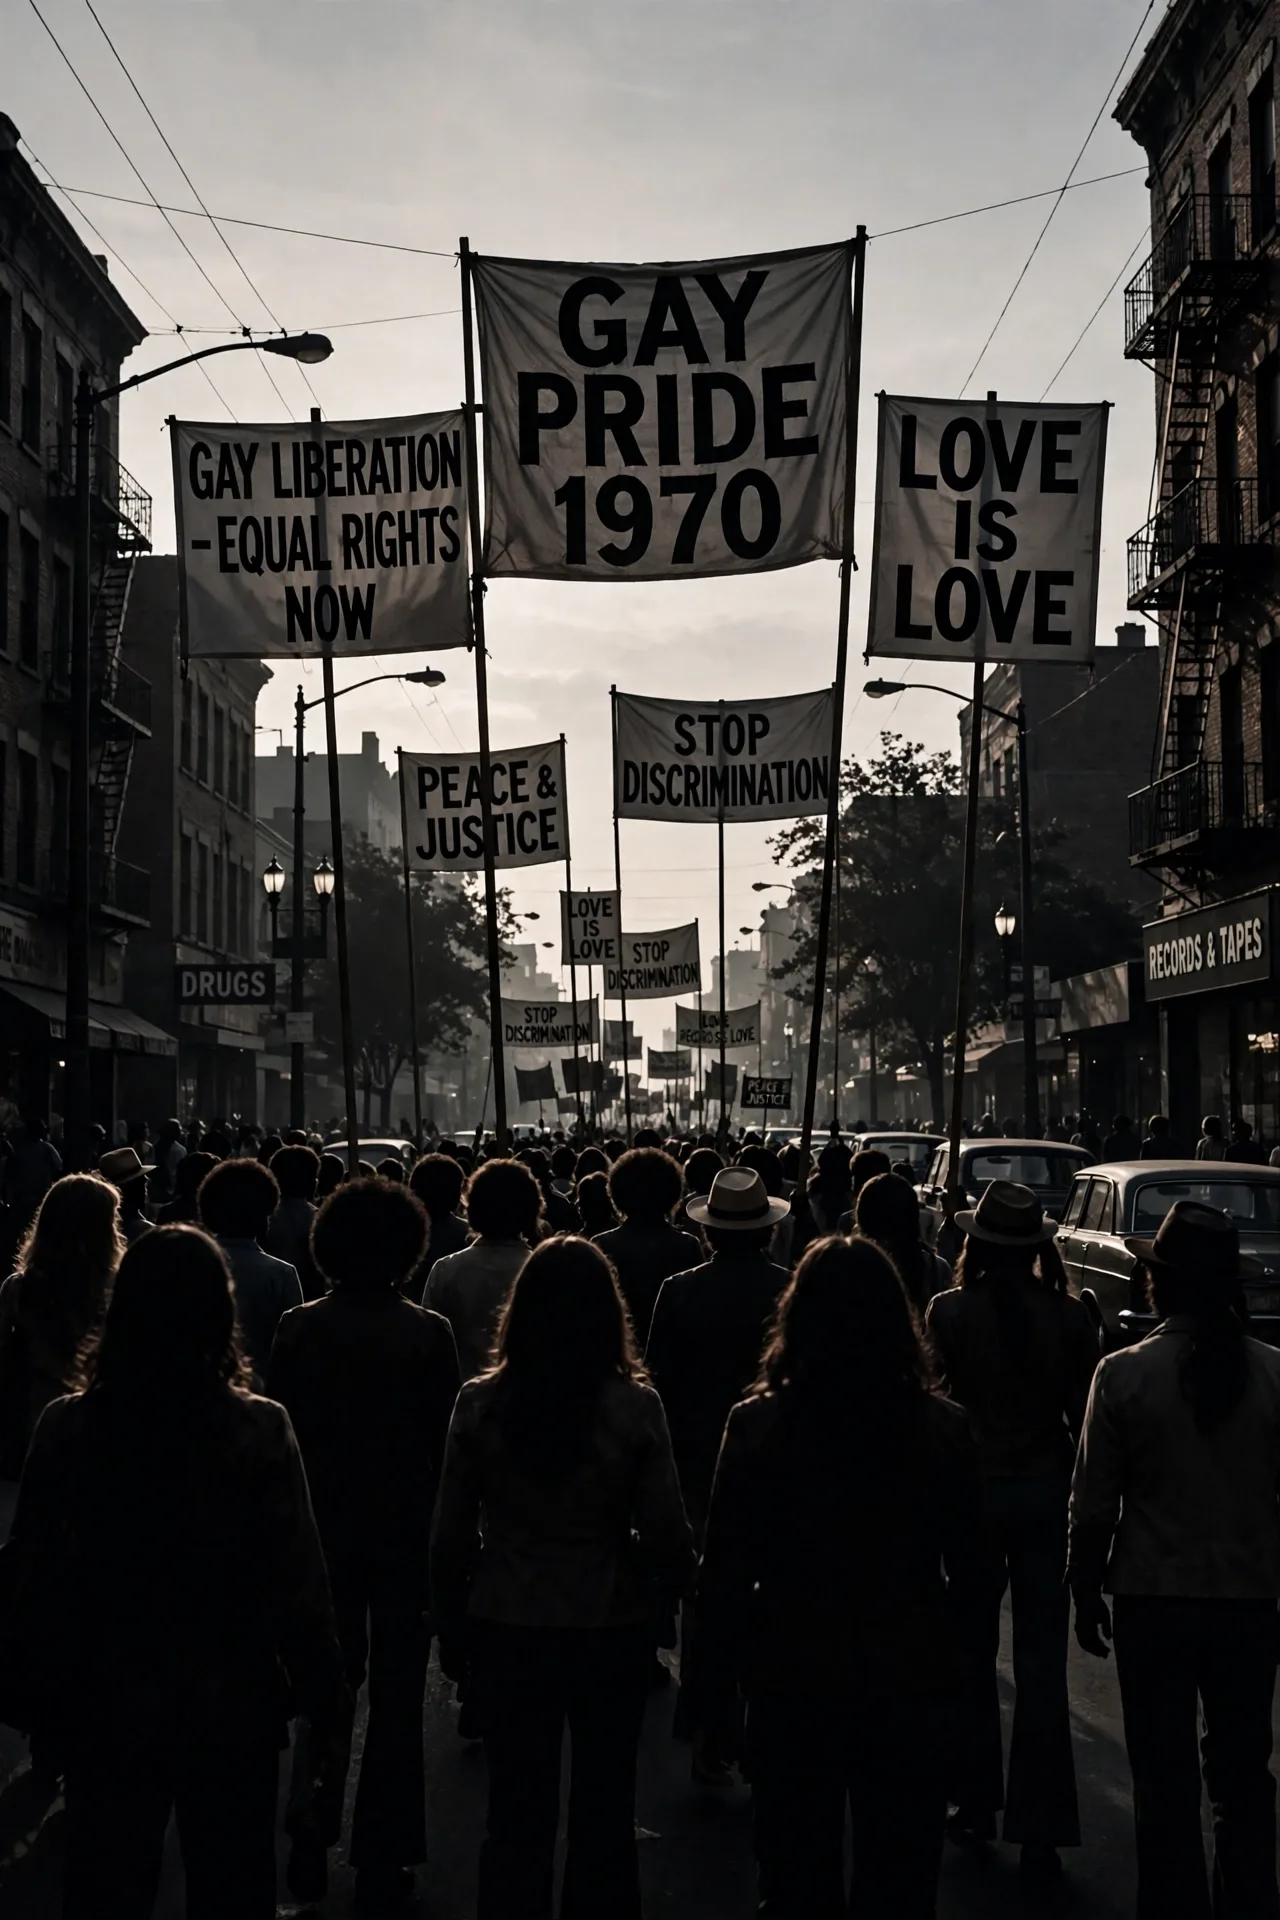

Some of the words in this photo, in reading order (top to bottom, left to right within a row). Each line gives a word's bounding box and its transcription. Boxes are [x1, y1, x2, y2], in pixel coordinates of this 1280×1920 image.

[558, 270, 770, 368] GAY
[517, 362, 819, 467] PRIDE
[188, 441, 260, 499] GAY
[271, 430, 463, 498] LIBERATION
[899, 414, 1082, 494] LOVE
[342, 505, 461, 570] RIGHTS
[554, 468, 781, 567] 1970
[954, 499, 1018, 562] IS
[284, 583, 376, 643] NOW
[895, 564, 1075, 646] LOVE
[674, 713, 770, 756] STOP
[417, 760, 530, 810] PEACE
[537, 764, 558, 799] &
[623, 756, 829, 808] DISCRIMINATION
[416, 807, 560, 860] JUSTICE
[568, 897, 613, 918] LOVE
[583, 919, 600, 937] IS
[571, 938, 616, 959] LOVE
[632, 940, 670, 964] STOP
[1149, 933, 1203, 981] RECORDS
[1207, 931, 1217, 968] &
[1219, 917, 1263, 965] TAPES
[181, 970, 267, 997] DRUGS
[524, 1006, 558, 1023] STOP
